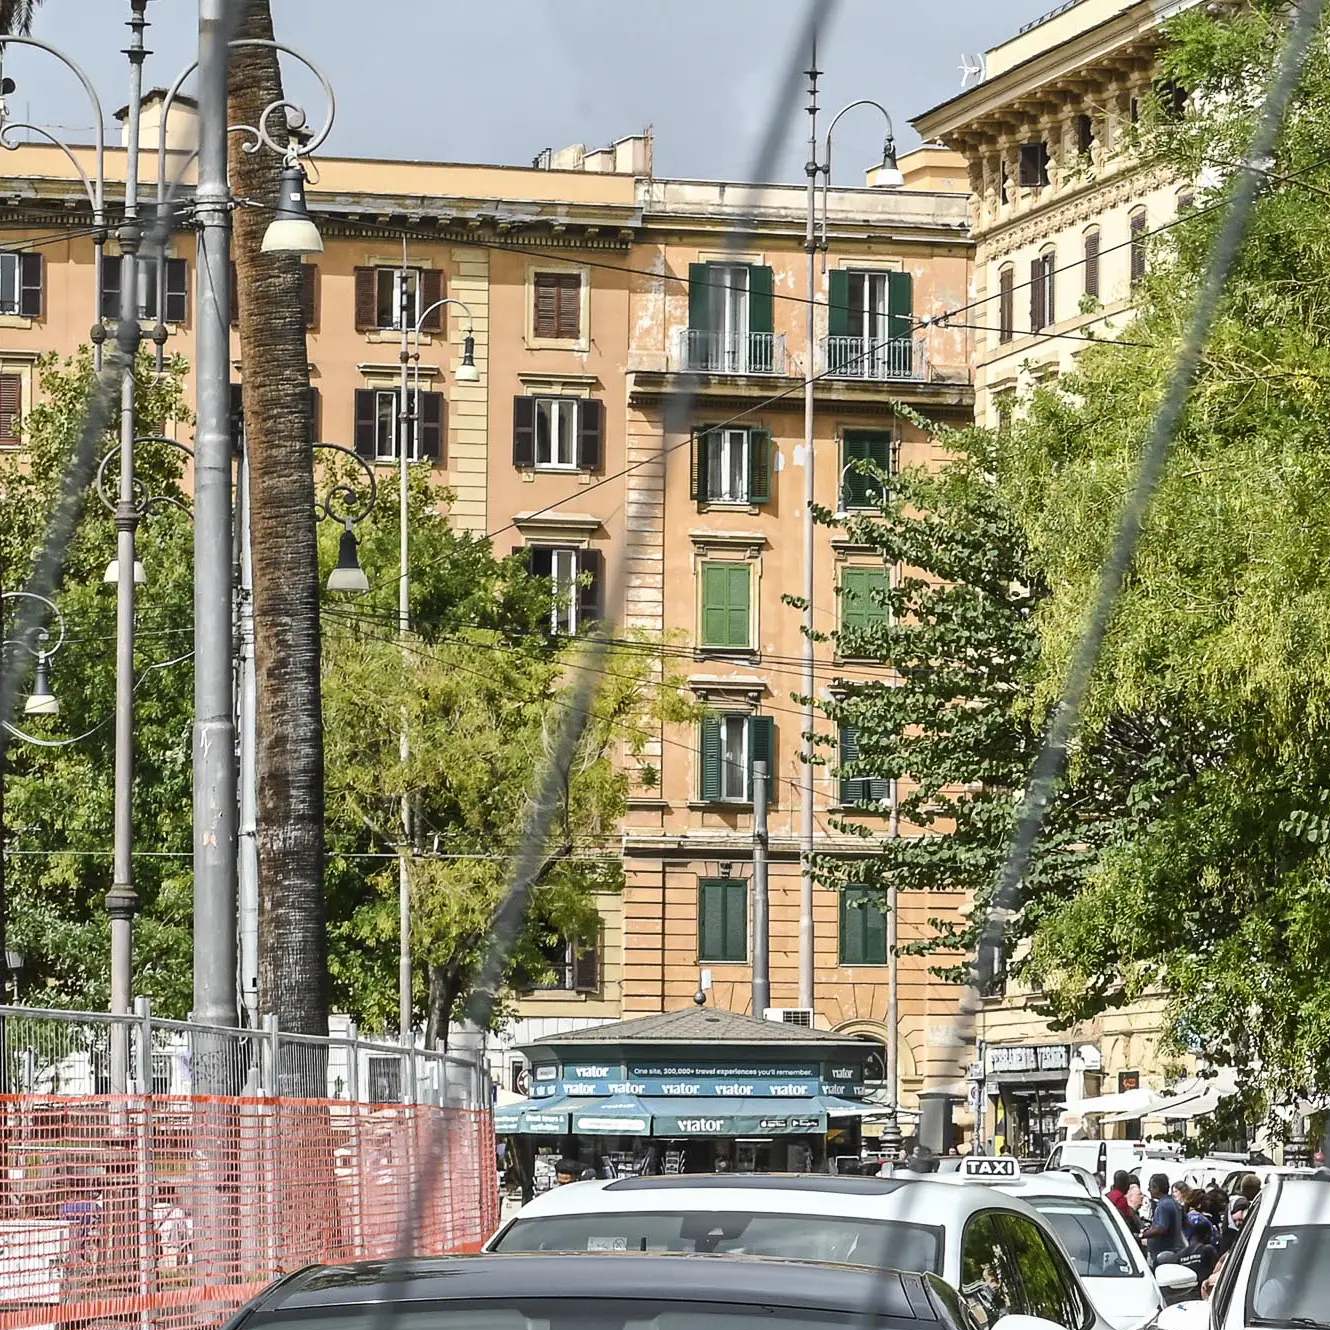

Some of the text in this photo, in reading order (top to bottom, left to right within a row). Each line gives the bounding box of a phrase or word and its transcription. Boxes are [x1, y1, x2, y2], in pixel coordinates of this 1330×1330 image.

[576, 1066, 611, 1078] viator
[717, 1068, 757, 1076] experiences
[832, 1068, 854, 1079] viator
[563, 1083, 597, 1095] viator
[608, 1082, 646, 1095] viator
[661, 1083, 701, 1095] viator
[715, 1083, 754, 1095] viator
[769, 1083, 808, 1095] viator
[822, 1084, 846, 1095] viator
[677, 1118, 725, 1132] viator
[967, 1161, 1013, 1174] TAXI
